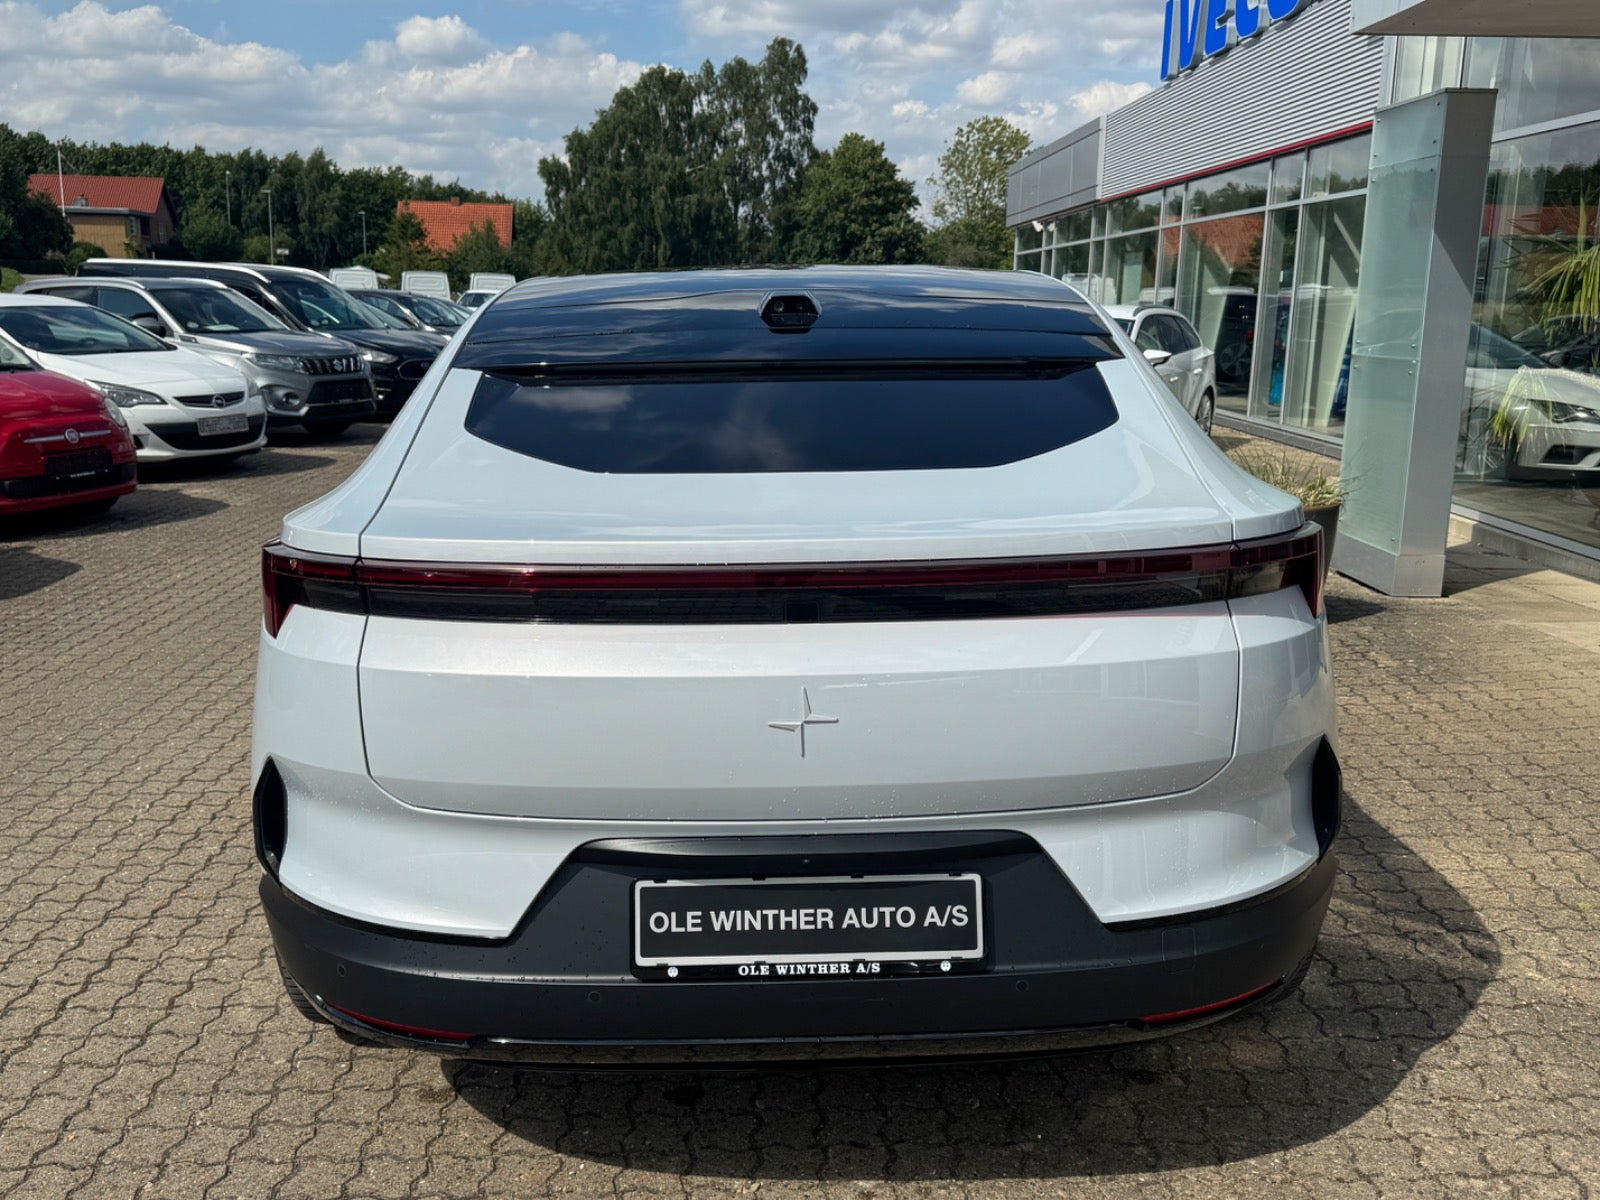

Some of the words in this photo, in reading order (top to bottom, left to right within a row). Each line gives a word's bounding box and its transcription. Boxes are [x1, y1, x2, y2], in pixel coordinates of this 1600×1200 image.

[649, 911, 703, 934] OLE
[709, 907, 834, 932] WINTHER
[841, 906, 916, 930] AUTO
[923, 904, 969, 928] A/S
[738, 964, 770, 976] OLE
[775, 963, 851, 976] WINTHER
[855, 962, 881, 974] A/S
